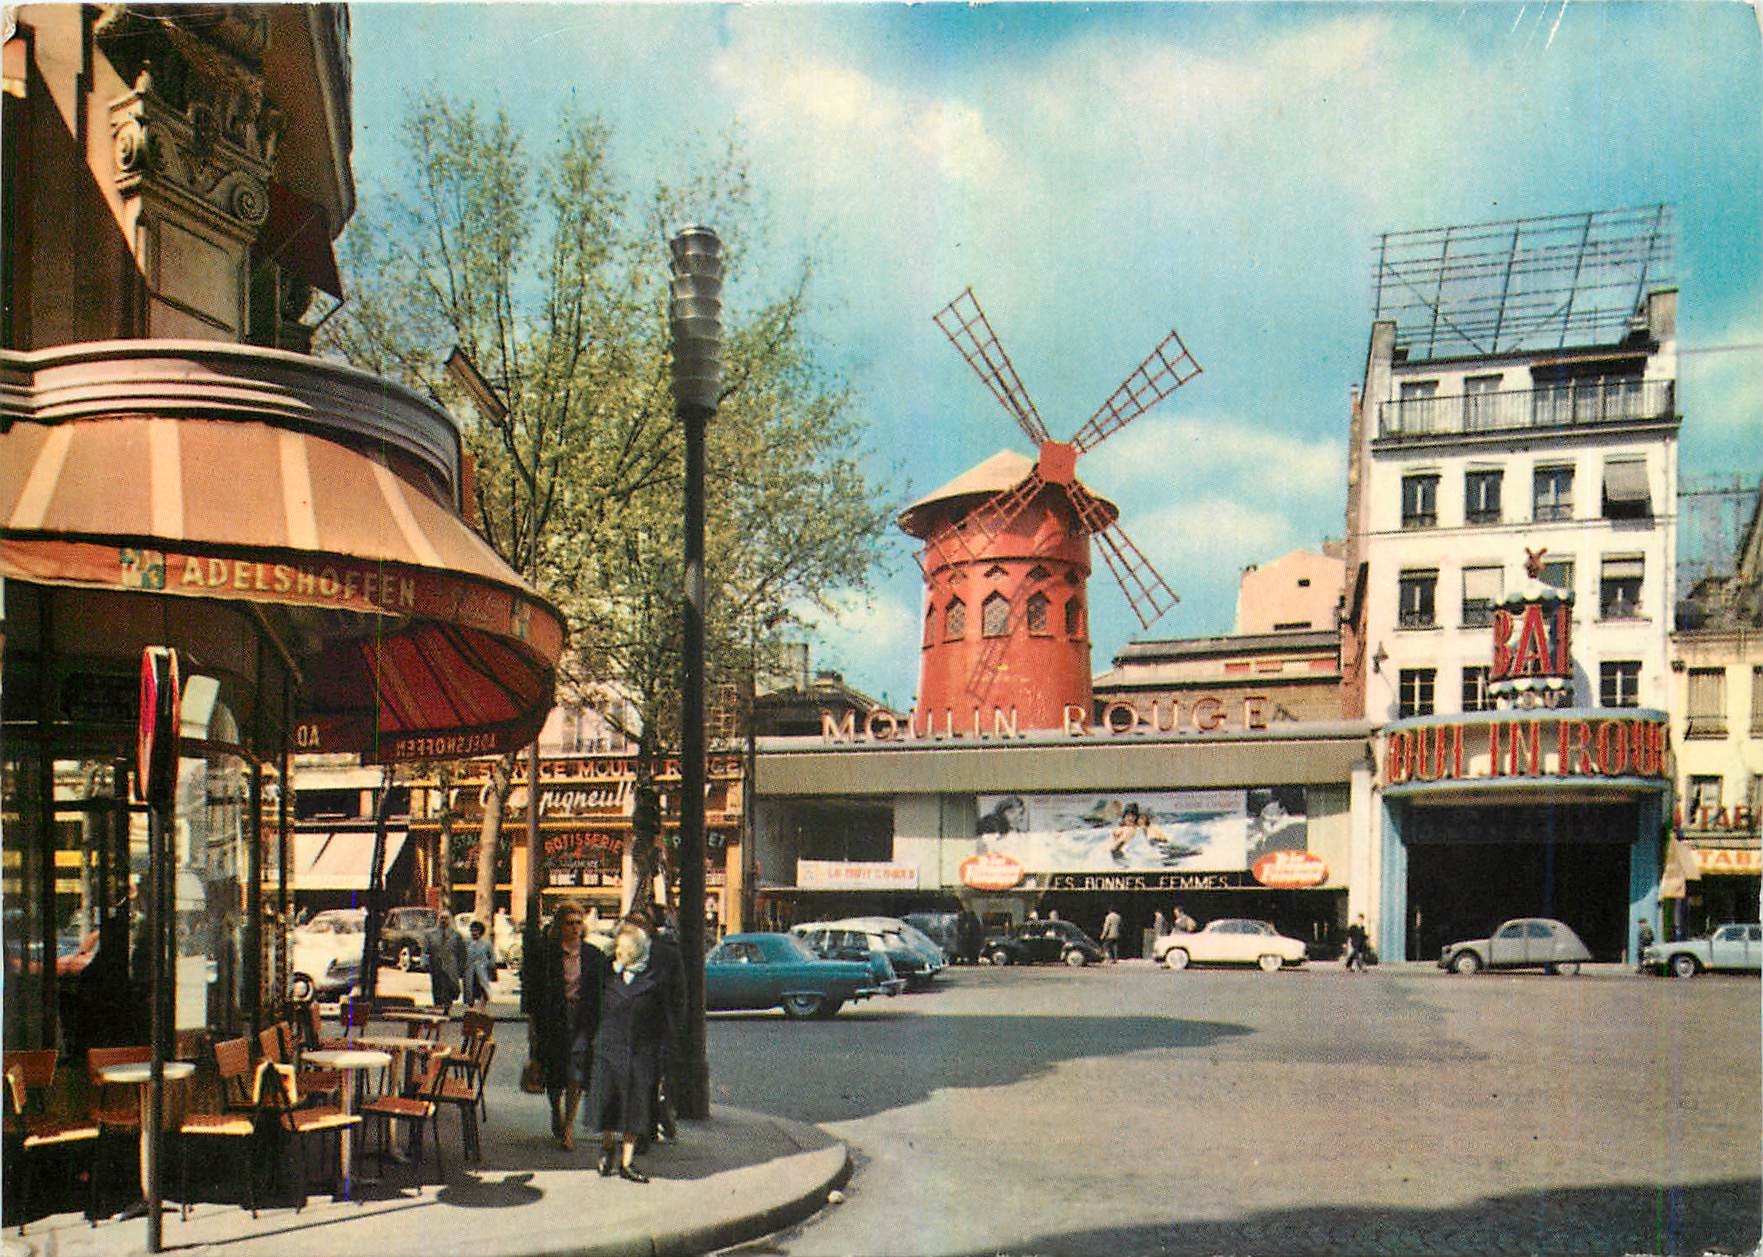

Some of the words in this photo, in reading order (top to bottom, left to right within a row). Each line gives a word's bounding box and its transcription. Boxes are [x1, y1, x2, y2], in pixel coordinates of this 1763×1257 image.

[179, 555, 416, 608] ADELSHOFFEN
[822, 704, 1021, 744] MOULIN
[1063, 696, 1269, 738] ROUGE
[1700, 803, 1762, 829] TAB
[1697, 849, 1762, 866] TAB
[1084, 874, 1145, 891] BONNES
[1158, 873, 1229, 890] FEMMES
